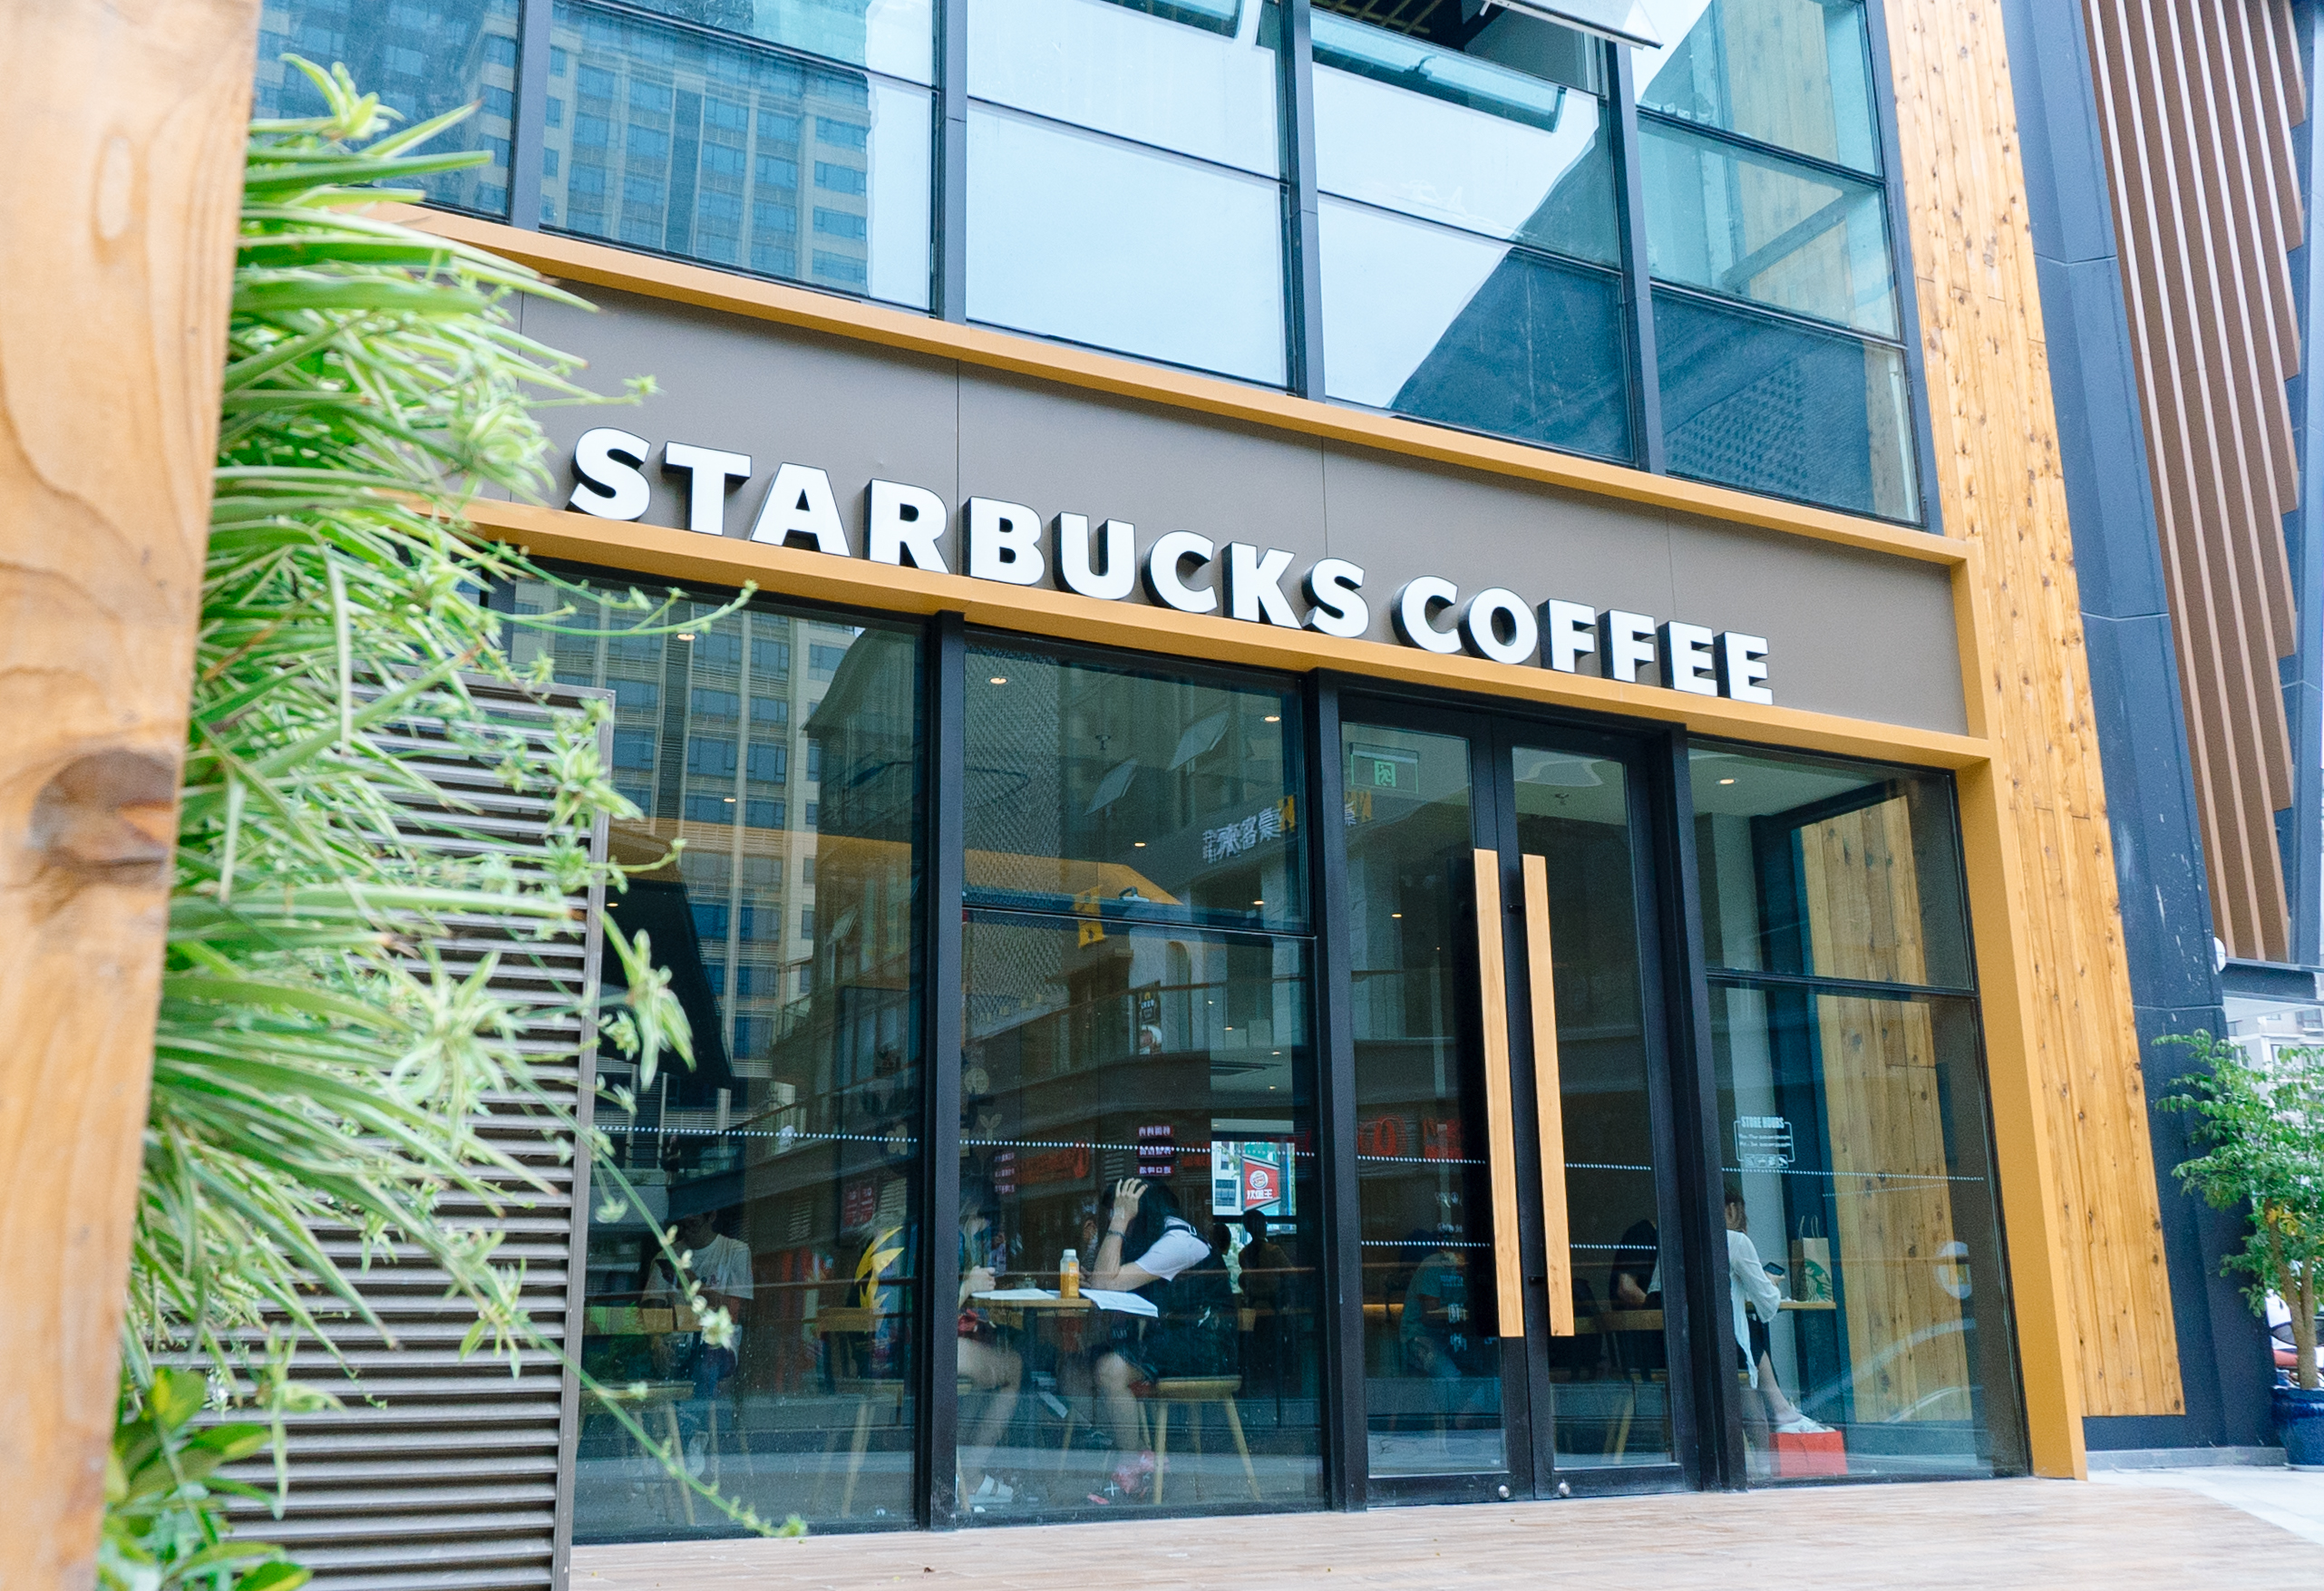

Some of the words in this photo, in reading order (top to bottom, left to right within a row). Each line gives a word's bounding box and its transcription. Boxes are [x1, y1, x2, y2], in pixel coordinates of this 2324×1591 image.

[565, 426, 1369, 637] STARBUCKS
[1391, 575, 1774, 705] COFFEE
[1741, 1115, 1762, 1129] STORE
